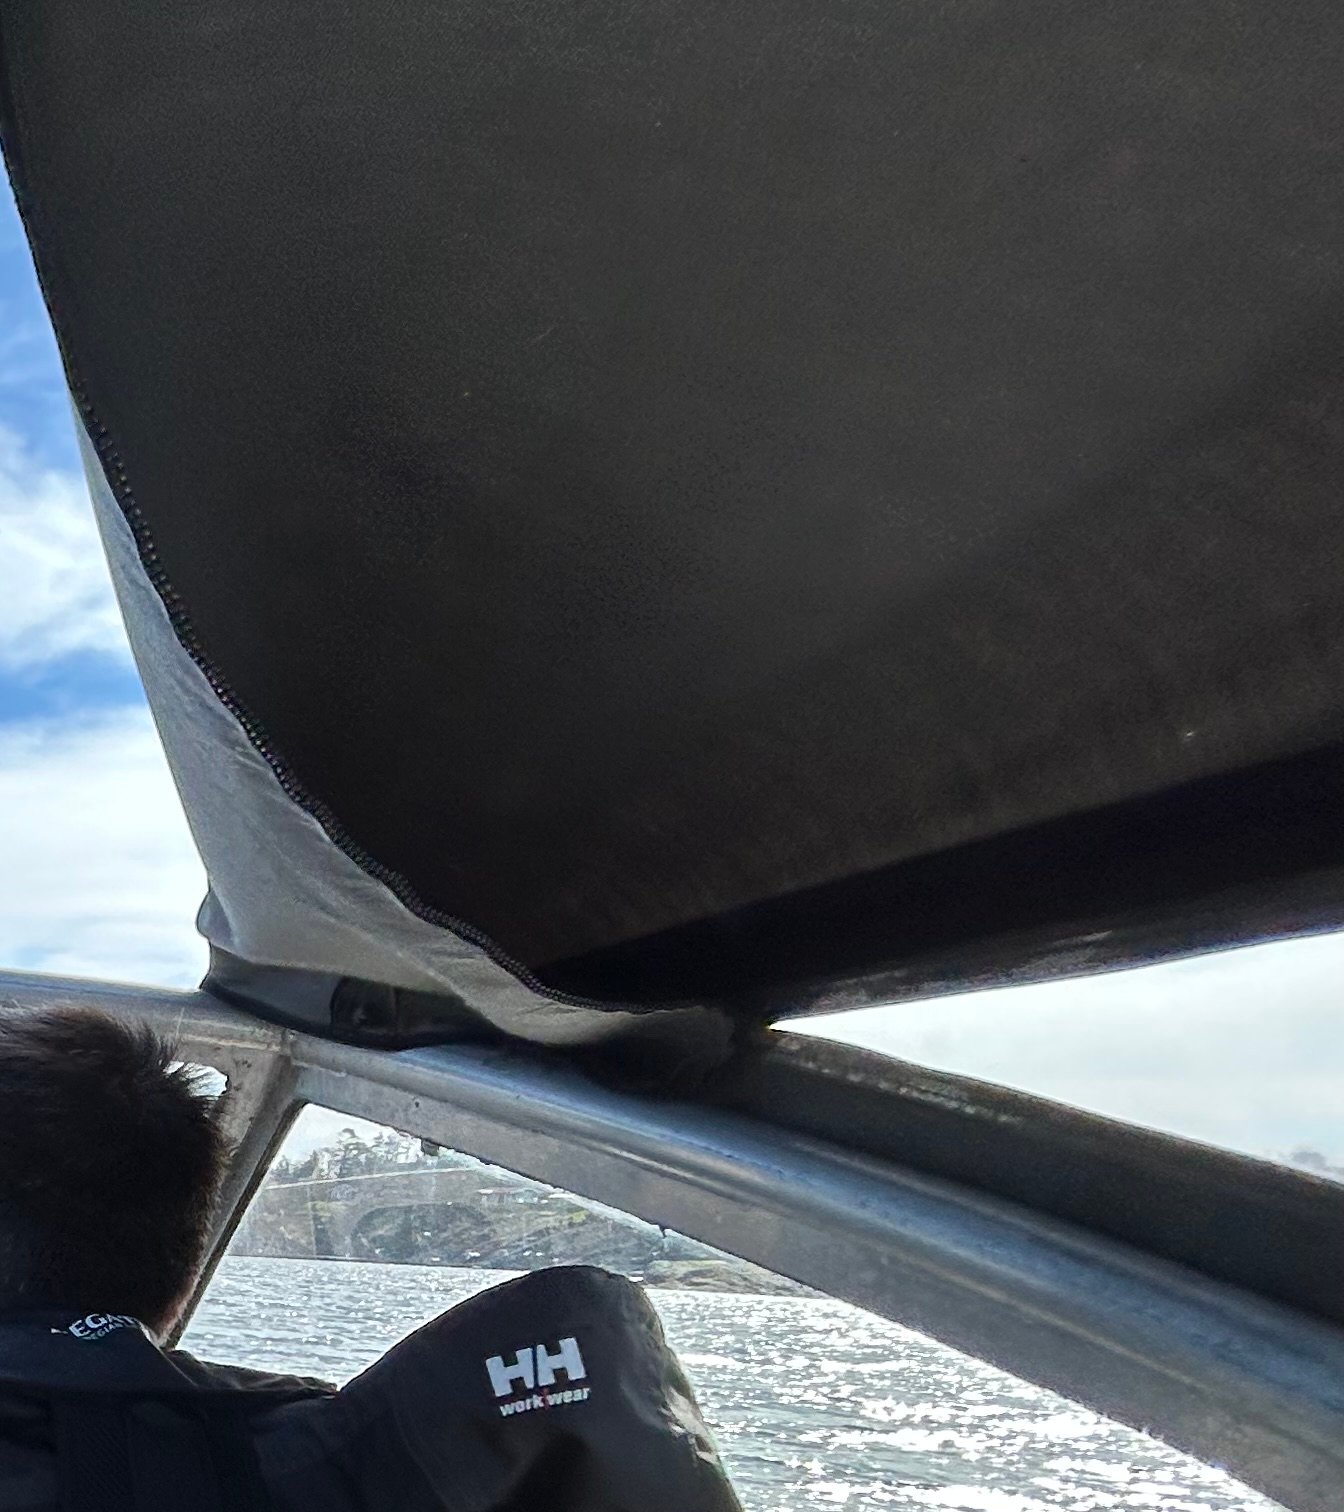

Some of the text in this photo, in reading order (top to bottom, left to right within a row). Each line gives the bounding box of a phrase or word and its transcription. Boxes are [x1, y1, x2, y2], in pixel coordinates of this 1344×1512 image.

[485, 1337, 588, 1397] HH
[499, 1388, 591, 1417] work wear
